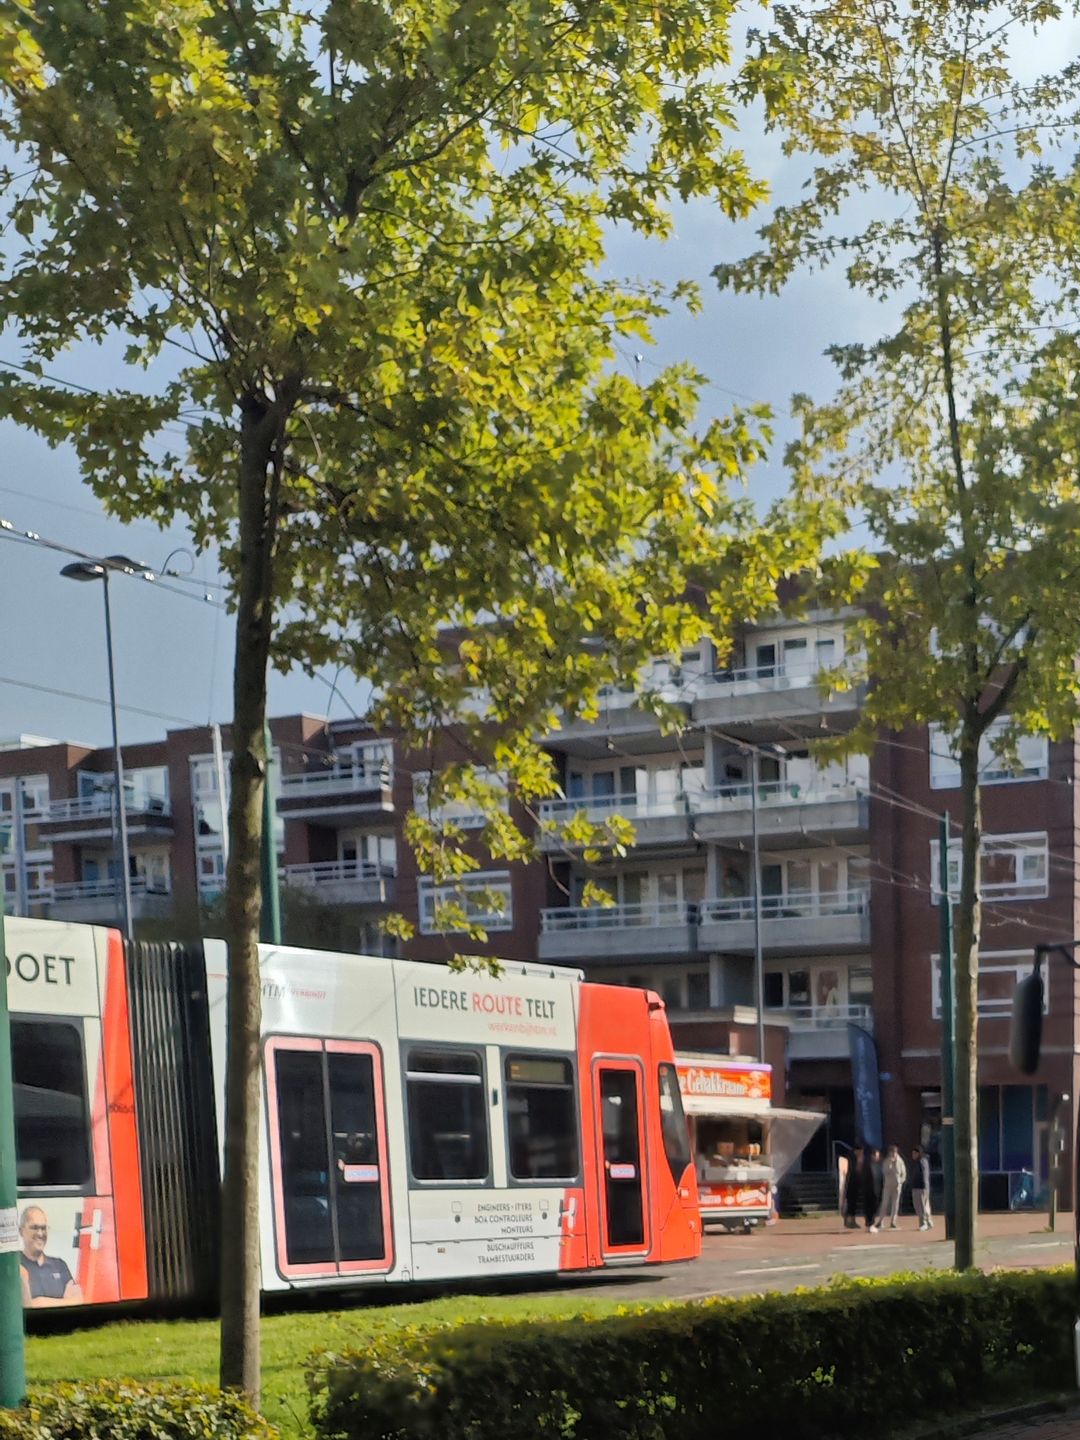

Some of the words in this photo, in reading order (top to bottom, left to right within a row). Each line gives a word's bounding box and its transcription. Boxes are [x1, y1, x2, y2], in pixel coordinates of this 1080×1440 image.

[5, 953, 76, 985] OET
[413, 986, 468, 1011] IEDERE
[472, 992, 522, 1016] ROUTE
[525, 998, 556, 1020] TELT
[501, 1225, 533, 1234] MONTEURS
[487, 1242, 534, 1252] BUSCHAUFFEURS
[478, 1253, 535, 1264] TRAMBESTUURDERS
